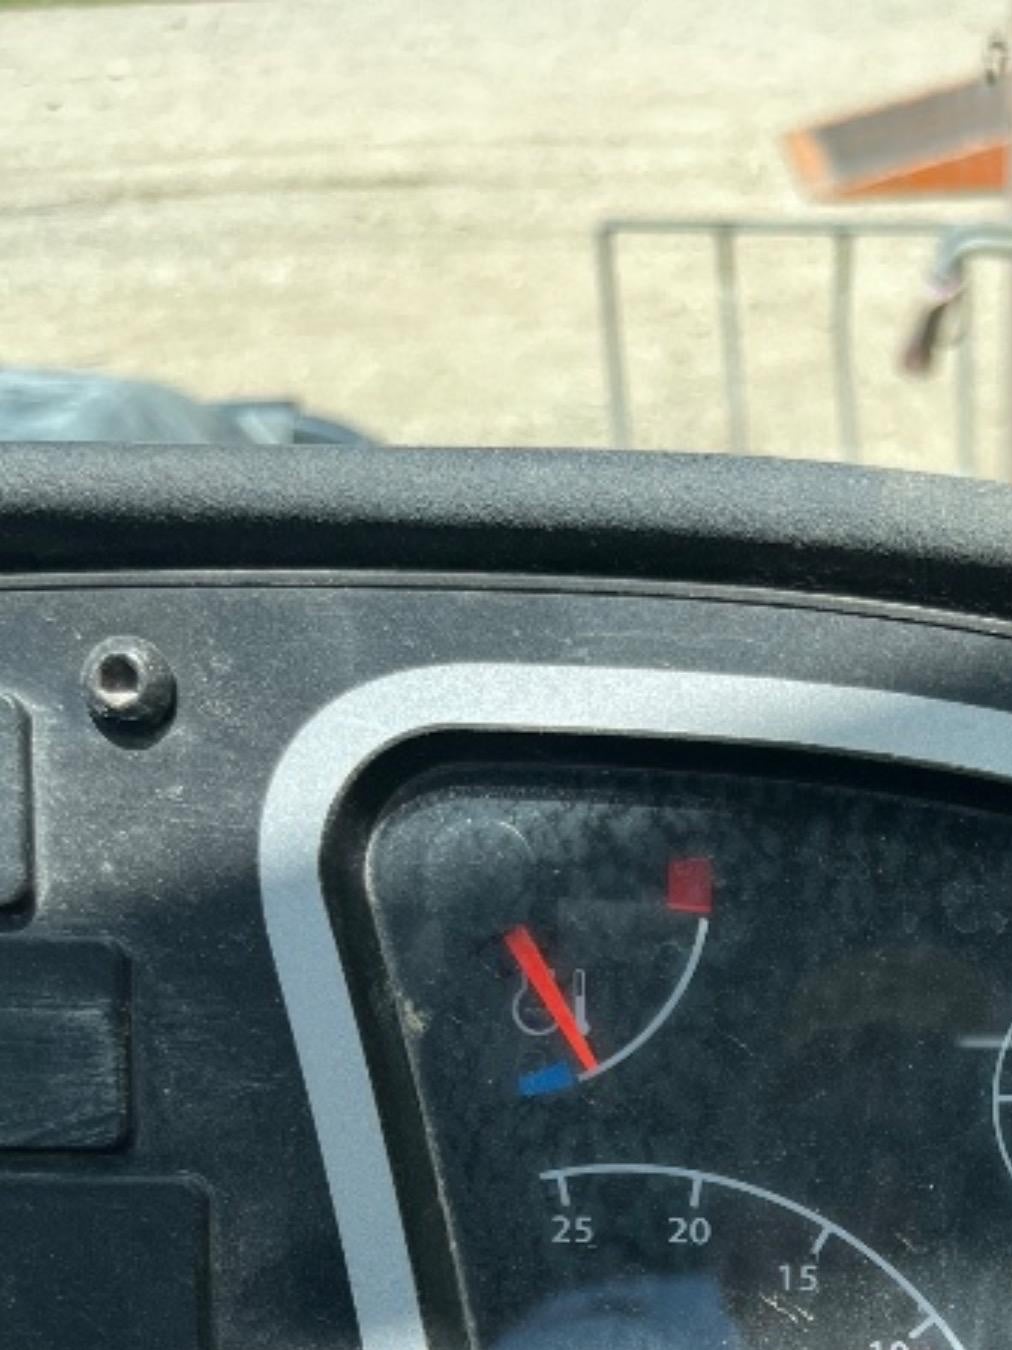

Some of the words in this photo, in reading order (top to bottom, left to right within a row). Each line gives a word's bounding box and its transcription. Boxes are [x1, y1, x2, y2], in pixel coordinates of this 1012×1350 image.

[551, 1217, 593, 1244] 25
[668, 1217, 711, 1244] 20
[779, 1265, 818, 1291] 15
